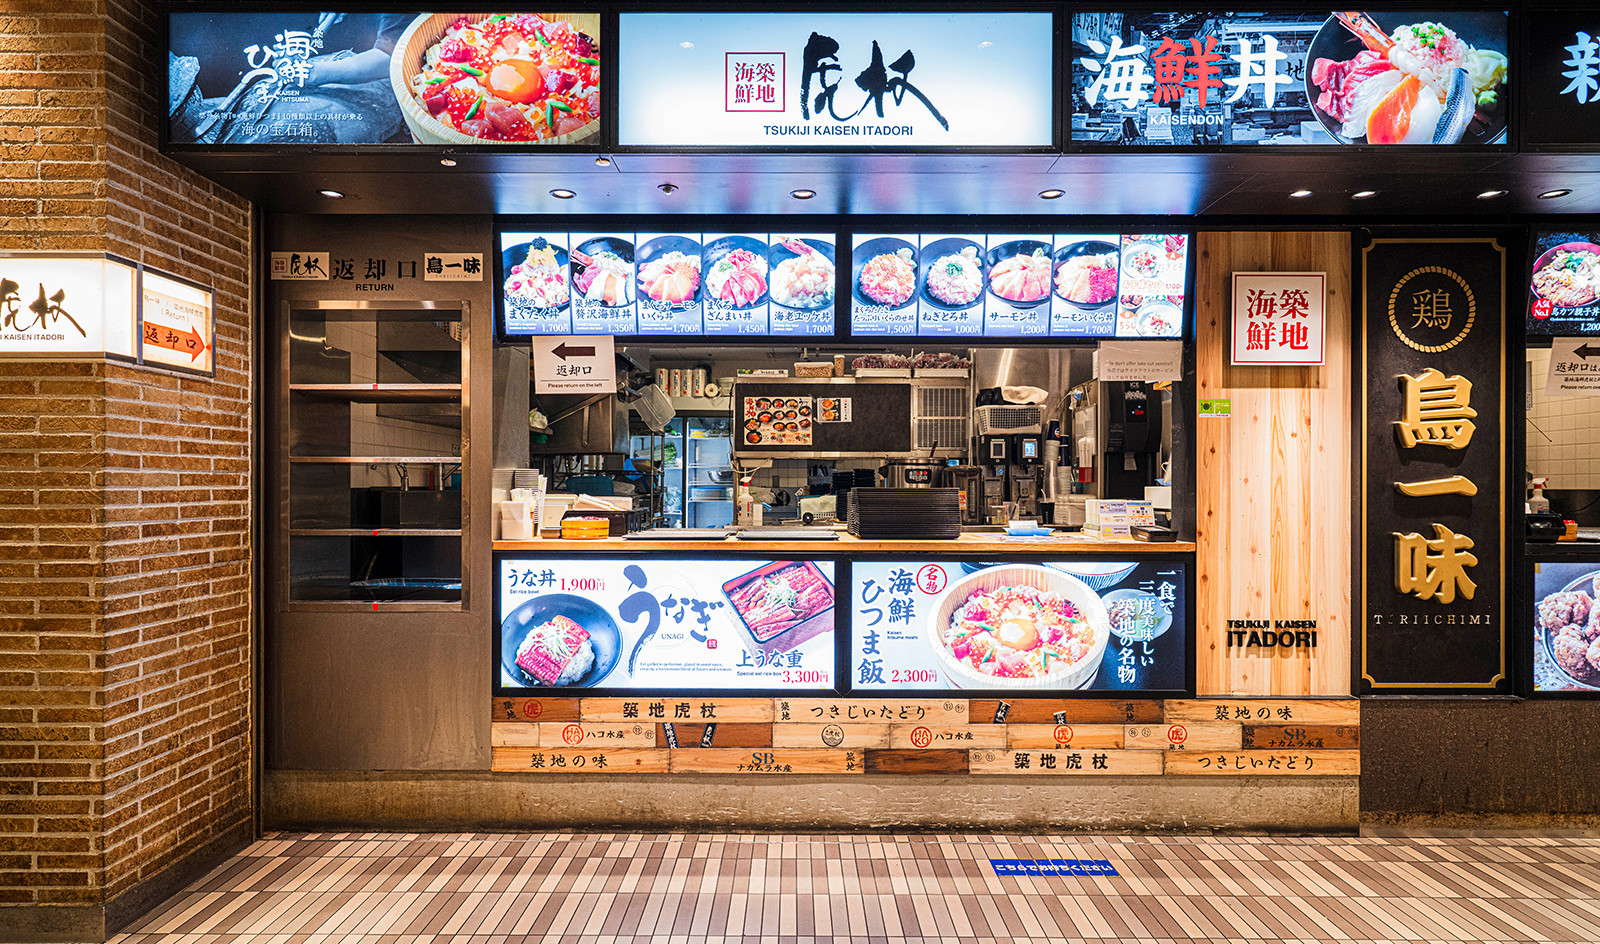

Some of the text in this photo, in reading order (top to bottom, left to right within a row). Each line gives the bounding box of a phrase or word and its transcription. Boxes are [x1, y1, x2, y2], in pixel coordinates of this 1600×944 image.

[275, 30, 319, 87] 海鮮
[239, 44, 280, 104] ひつま
[1080, 34, 1294, 110] 海鮮丼
[1150, 114, 1225, 126] KAISENDON
[241, 122, 319, 138] 海の宝石箱。
[763, 125, 914, 136] TSUKIJI KAISEN ITADORI
[333, 258, 417, 281] 返却口
[426, 256, 482, 274] 鳥一味
[355, 283, 394, 292] RETURN
[922, 312, 969, 322] ねぎとろ丼
[989, 312, 1038, 322] サーモン丼
[1054, 312, 1114, 322] サーモンいくら丼
[1410, 288, 1454, 331] 鶏
[145, 325, 198, 350] 返却口
[556, 365, 593, 377] 返却口
[1555, 362, 1600, 373] 返却口は
[1393, 368, 1479, 605] 鳥一味
[508, 568, 557, 588] うな丼
[924, 567, 938, 593] 名物
[888, 568, 916, 625] 海鮮
[1156, 570, 1177, 615] 一食で
[618, 565, 724, 679] うなぎ
[1138, 579, 1156, 668] 三度美味しい
[1227, 620, 1317, 628] TSUKIJI KAISEN
[857, 579, 887, 685] ひつま飯
[1227, 631, 1317, 647] ITADORI
[1117, 598, 1137, 684] 築地の名物
[736, 649, 804, 669] 上うな重
[503, 701, 517, 720] 築地
[622, 702, 718, 719] 築地虎杖
[781, 701, 791, 721] 築地
[810, 704, 926, 720] つきじいたどり
[1125, 703, 1135, 722] 築地
[1214, 704, 1293, 721] 築地の味
[586, 730, 626, 740] ハコ水産
[934, 732, 974, 741] ハコ水産
[1246, 728, 1256, 748] 築地
[1283, 729, 1307, 741] SB
[1268, 740, 1325, 749] ナカムラ水産
[530, 752, 609, 769] 築地の味
[751, 752, 775, 765] SB
[846, 751, 856, 772] 築地
[1014, 753, 1109, 770] 築地虎杖
[1197, 755, 1314, 770] つきじいたどり
[737, 764, 793, 773] ナカムラ水産
